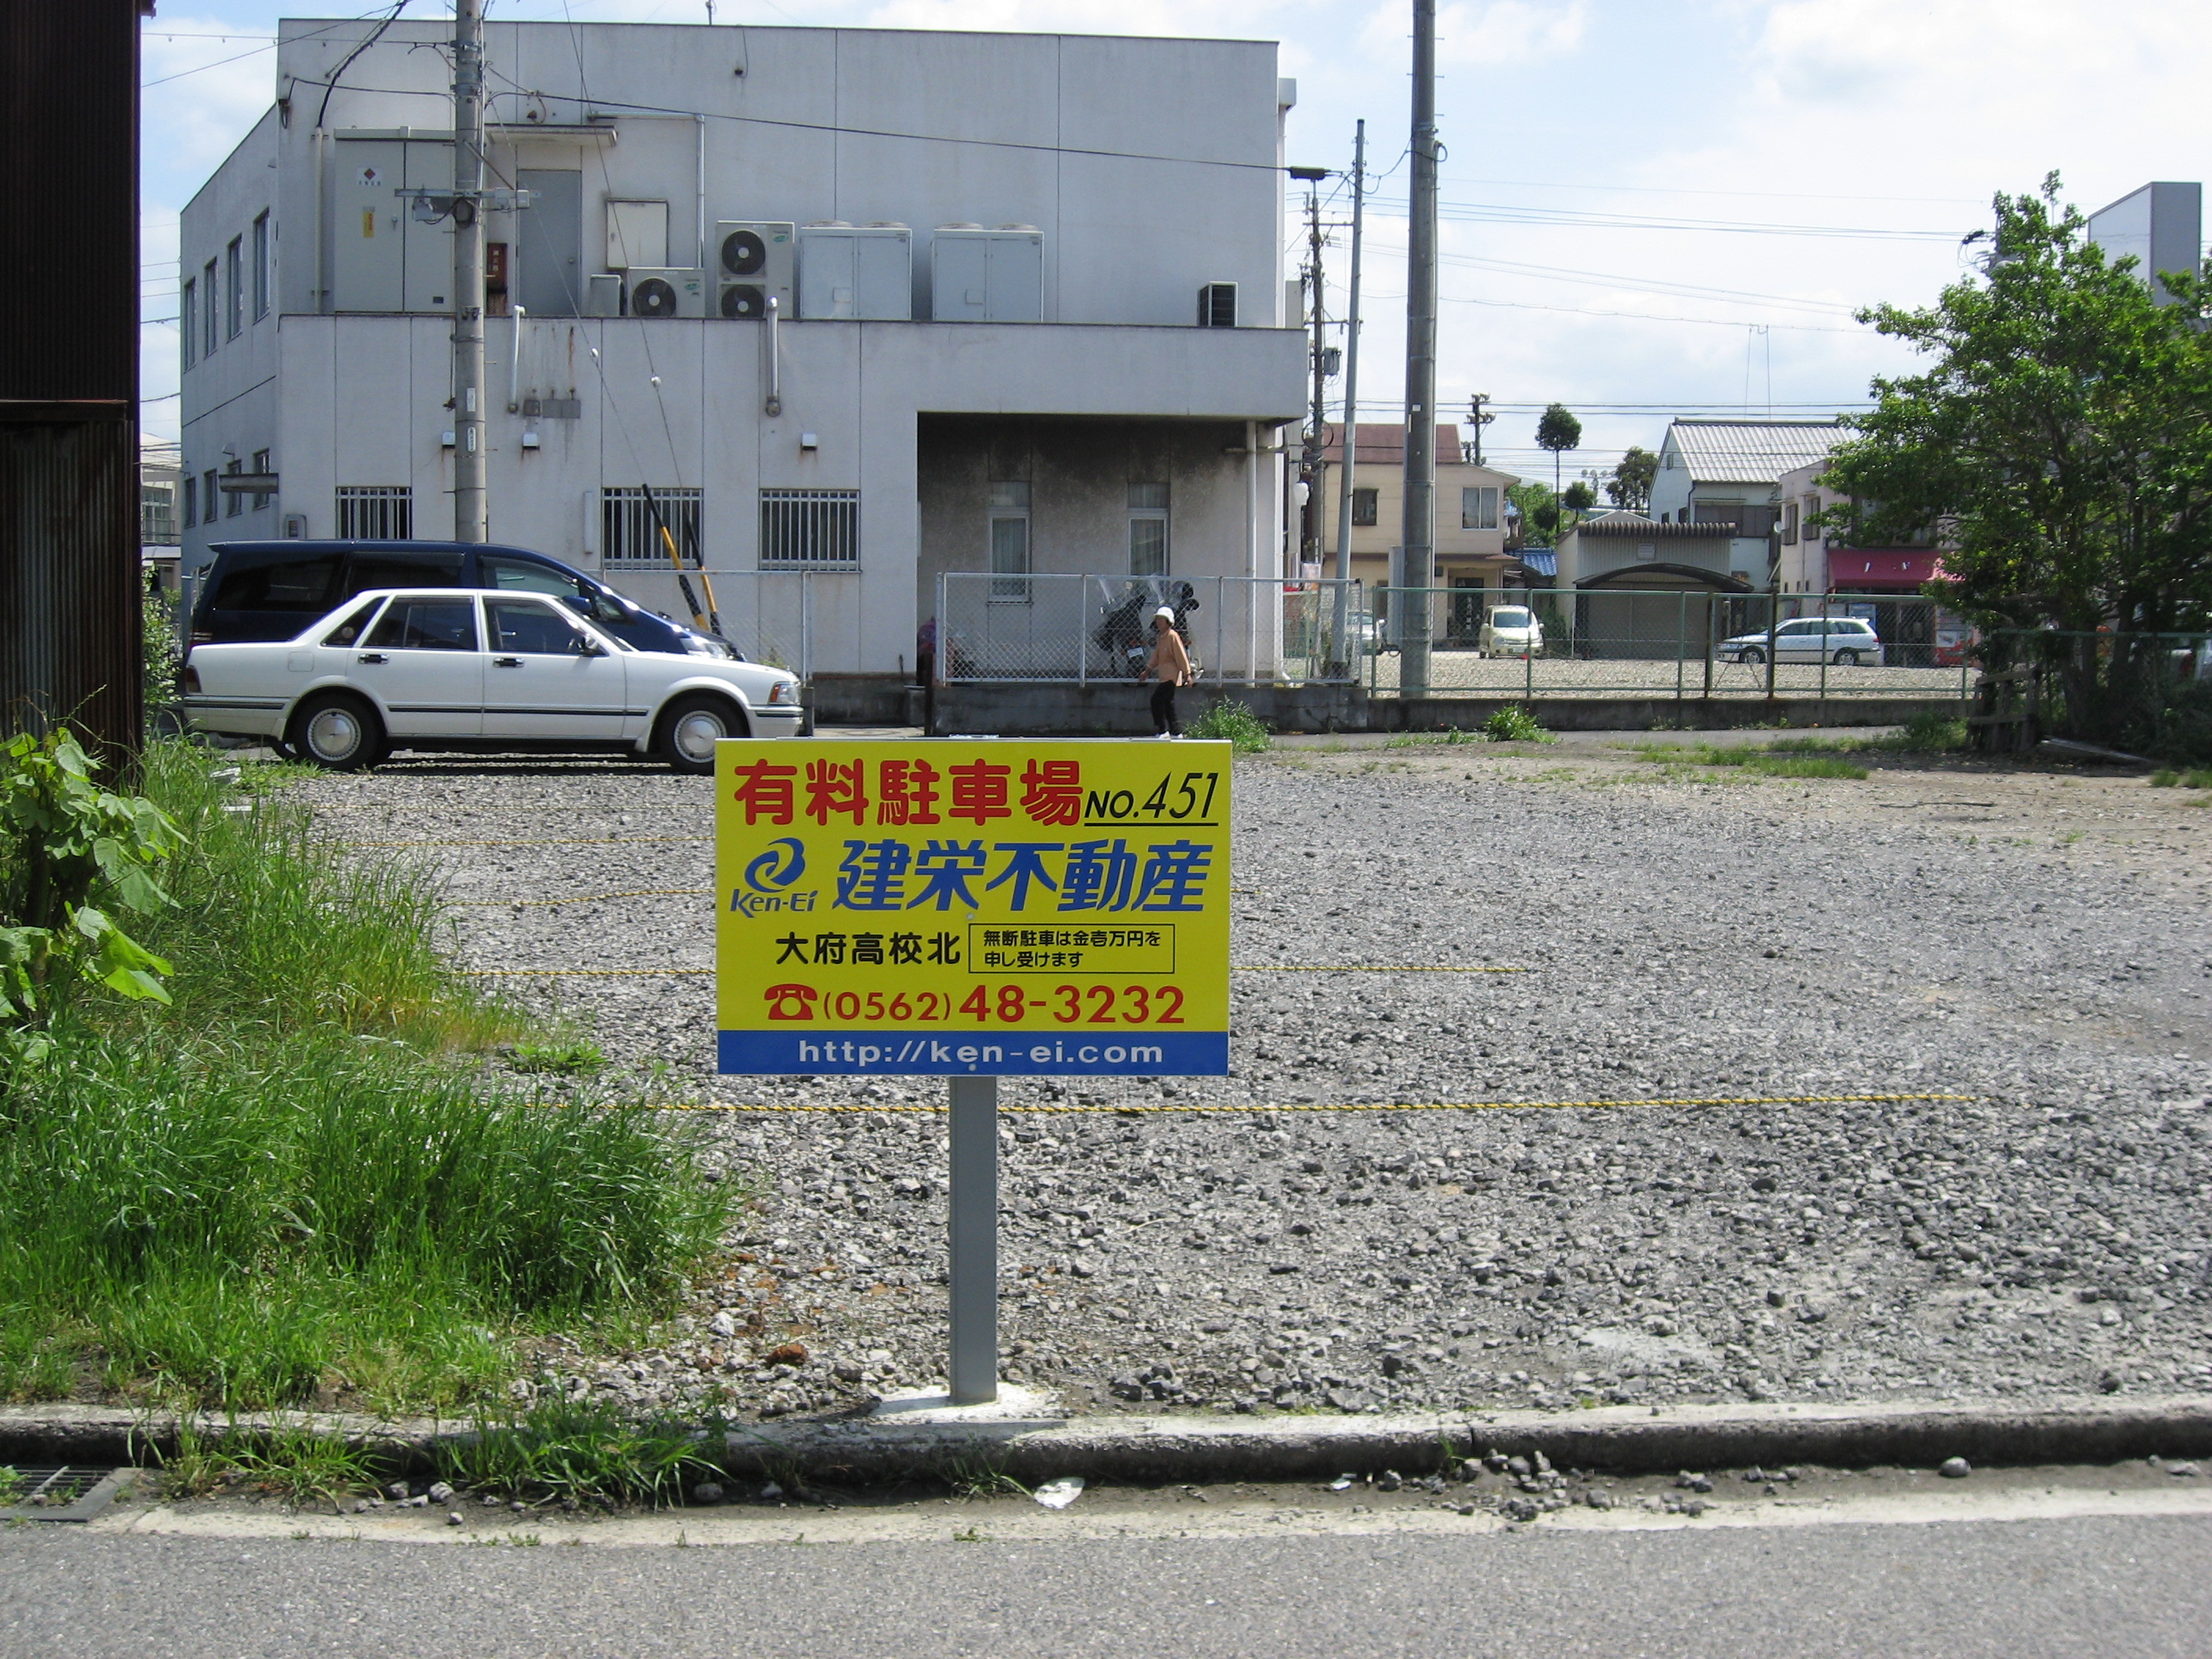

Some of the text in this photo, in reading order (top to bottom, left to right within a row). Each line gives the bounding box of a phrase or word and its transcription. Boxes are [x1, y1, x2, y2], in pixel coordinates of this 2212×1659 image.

[735, 759, 1082, 826] 有料駐車場
[833, 840, 1214, 912] 建栄不動産
[731, 888, 818, 918] Ken-Ei
[775, 932, 961, 965] 大府高校北
[983, 930, 1161, 947] 無断駐車は金壱万円を
[984, 951, 1084, 968] 申し受けます
[800, 1040, 1163, 1067] http://ken-ei.com
